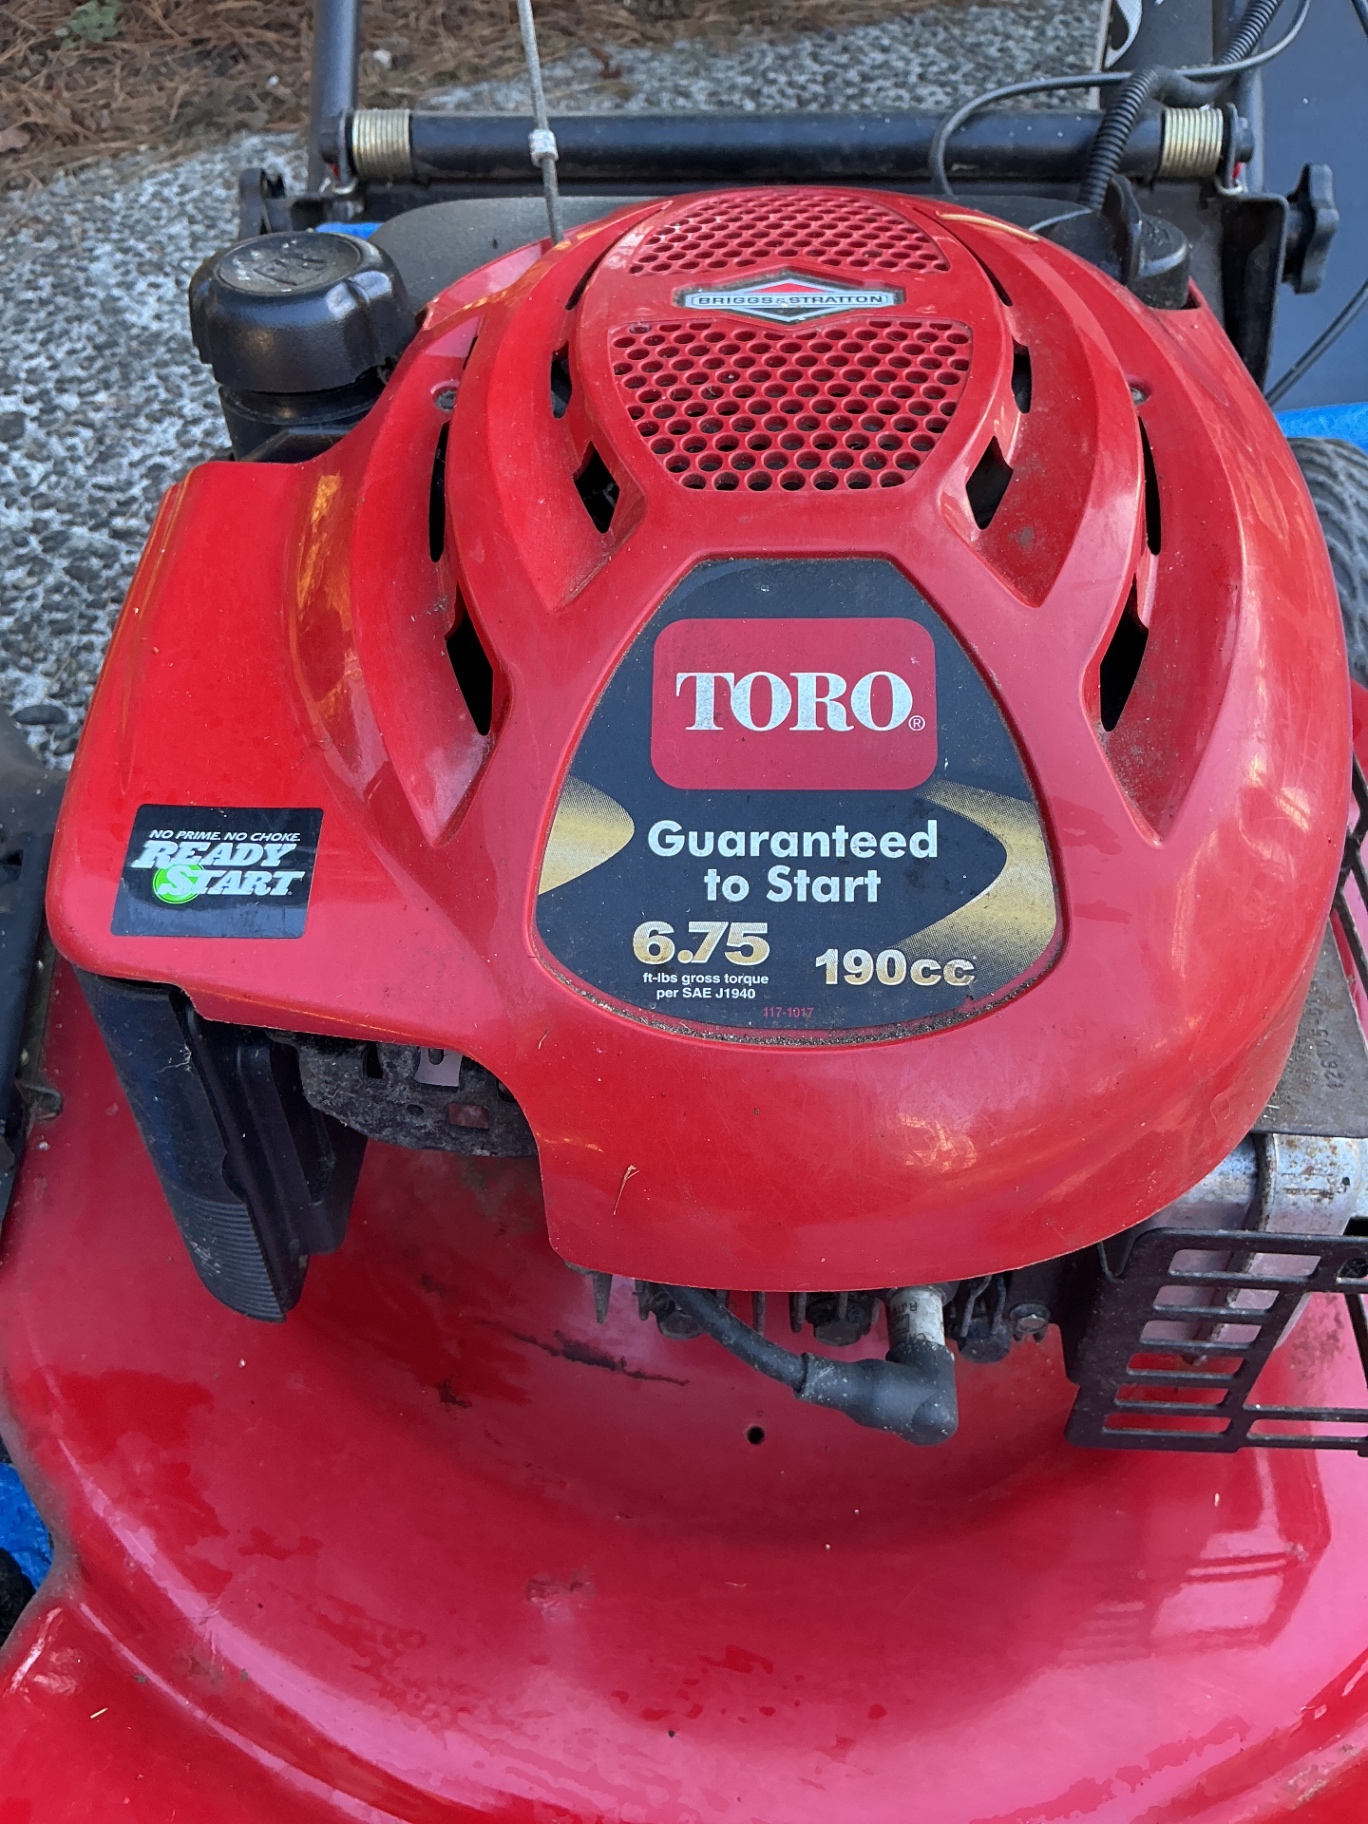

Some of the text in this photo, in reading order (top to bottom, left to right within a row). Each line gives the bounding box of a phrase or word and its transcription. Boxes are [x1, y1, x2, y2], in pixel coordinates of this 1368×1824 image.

[149, 829, 301, 842] NO PRIME. NO CHOKE.
[648, 819, 939, 859] Guaranteed
[131, 840, 297, 868] READY
[157, 864, 306, 896] START
[703, 865, 882, 903] to Start
[632, 921, 771, 966] 6.75
[643, 972, 770, 986] ft-lbs gross torque
[815, 948, 975, 986] 190cc
[656, 987, 756, 1000] per SAE J1940
[762, 1006, 814, 1018] 117-1017
